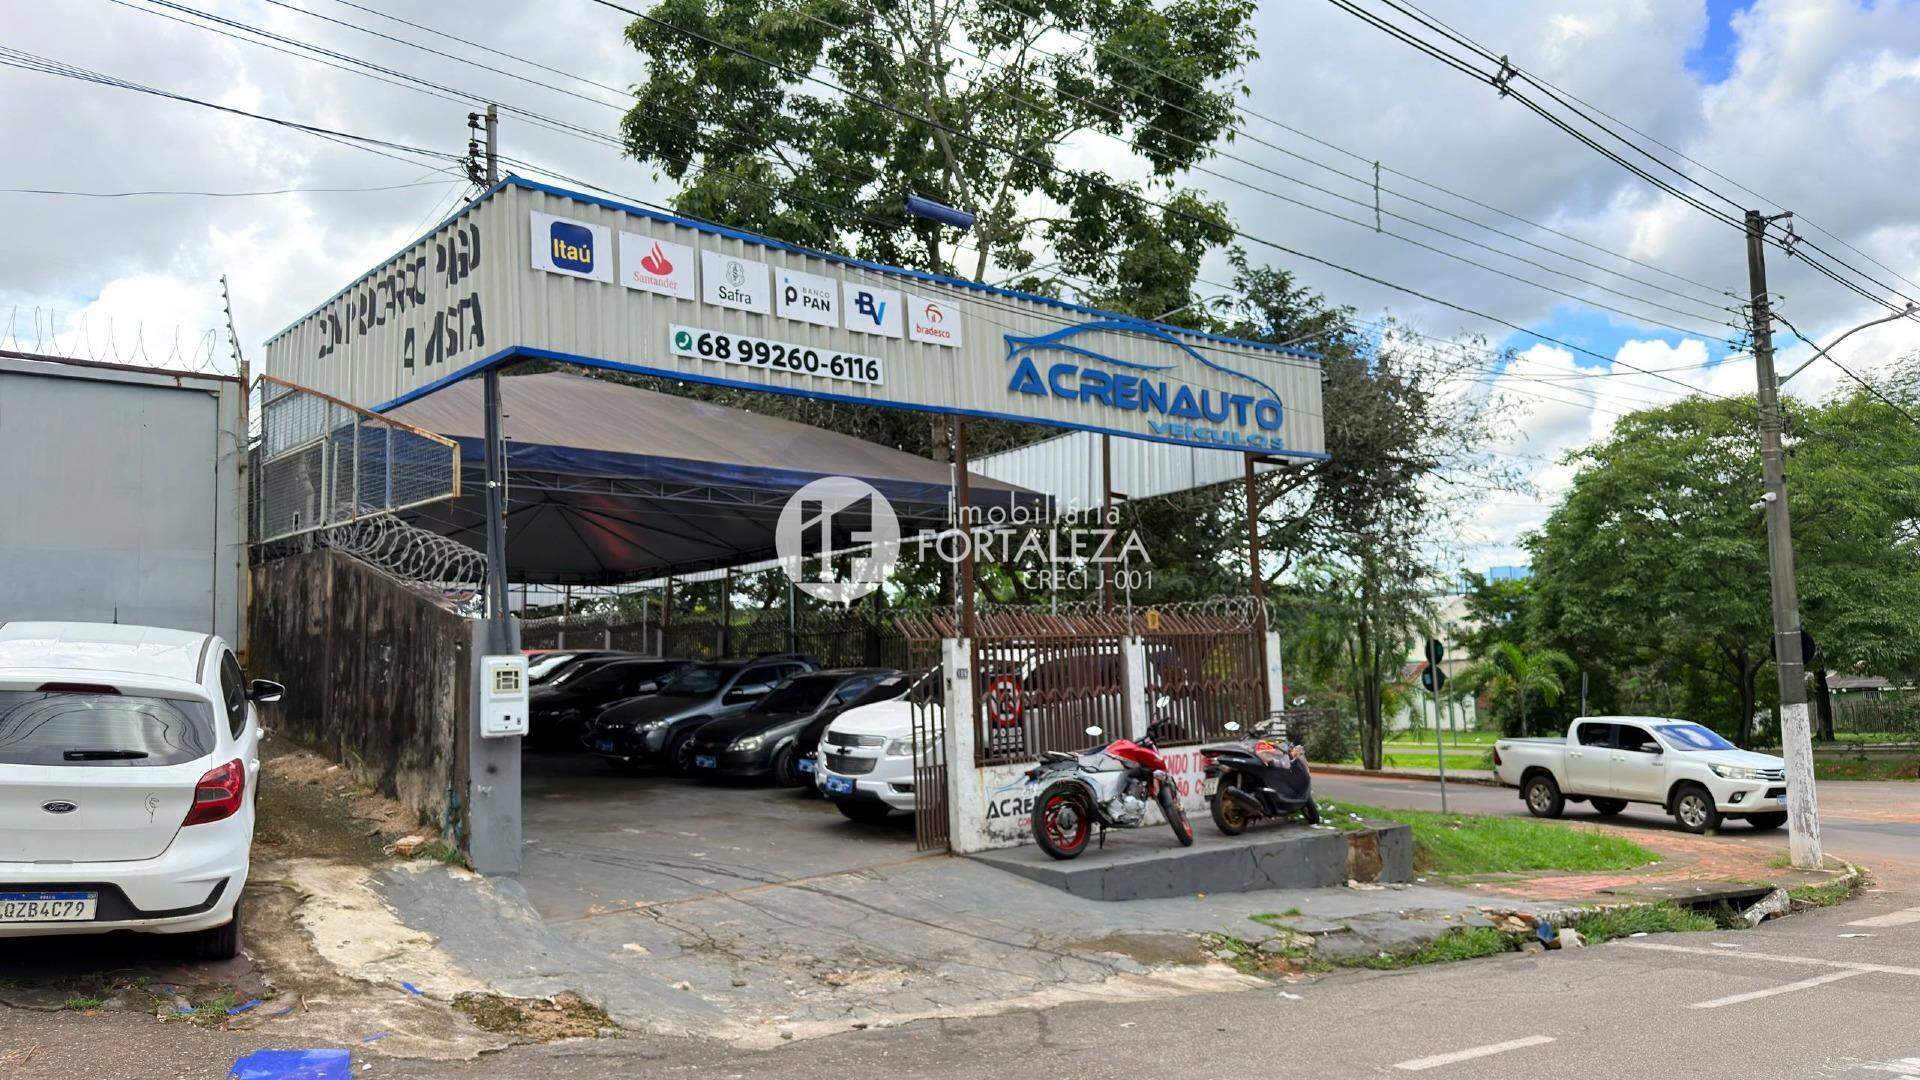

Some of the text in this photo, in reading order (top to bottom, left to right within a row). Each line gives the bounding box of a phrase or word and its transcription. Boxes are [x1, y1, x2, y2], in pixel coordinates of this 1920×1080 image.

[553, 239, 591, 264] Itaú
[633, 272, 678, 289] Santander
[719, 286, 752, 305] Safra
[802, 287, 830, 299] BANCO
[803, 296, 831, 312] PAN
[855, 291, 886, 325] BV
[425, 292, 484, 366] VISTA
[916, 323, 951, 339] bradesco
[697, 333, 879, 381] 68 99260-6116
[1008, 356, 1284, 431] ACRENAUTO
[4, 901, 85, 918] QZB4C79
